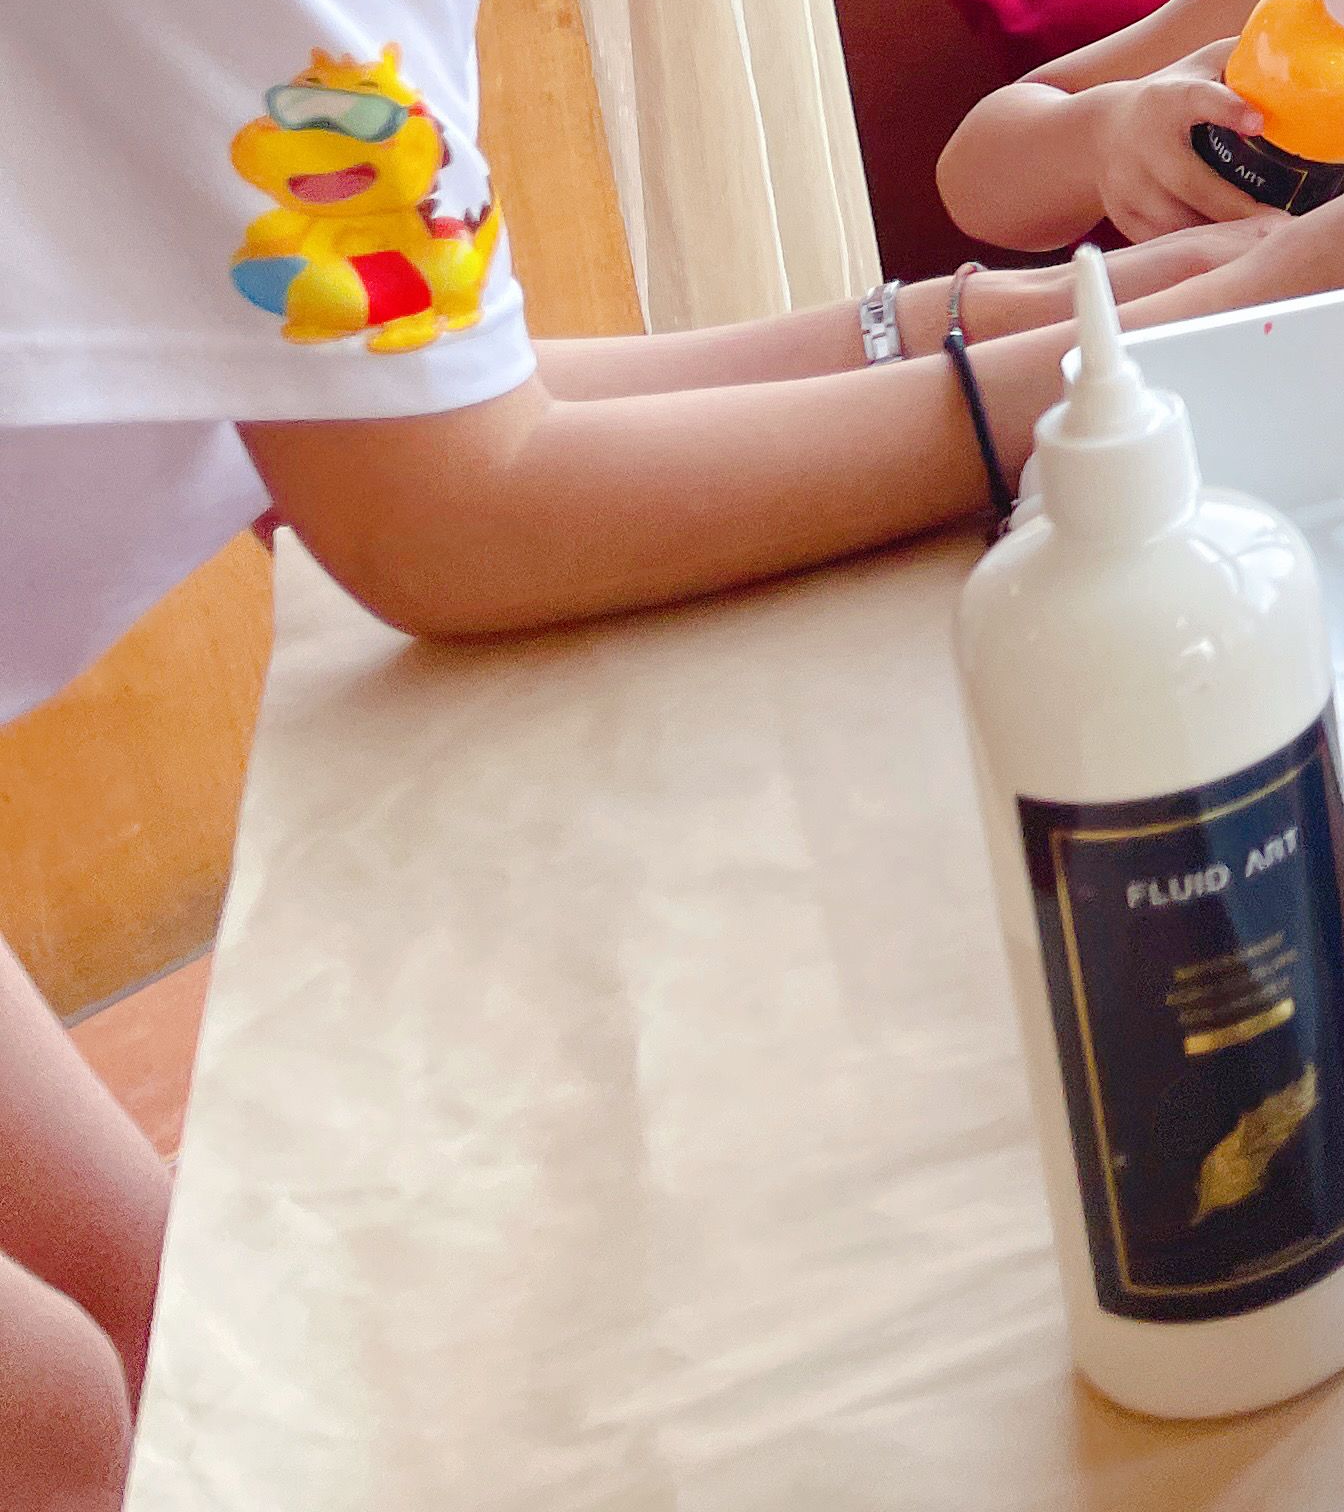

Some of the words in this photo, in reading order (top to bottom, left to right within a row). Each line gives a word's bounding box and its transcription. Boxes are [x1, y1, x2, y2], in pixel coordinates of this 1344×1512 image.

[1235, 165, 1266, 187] ART
[1126, 861, 1232, 909] FLUID
[1245, 825, 1298, 878] ART
